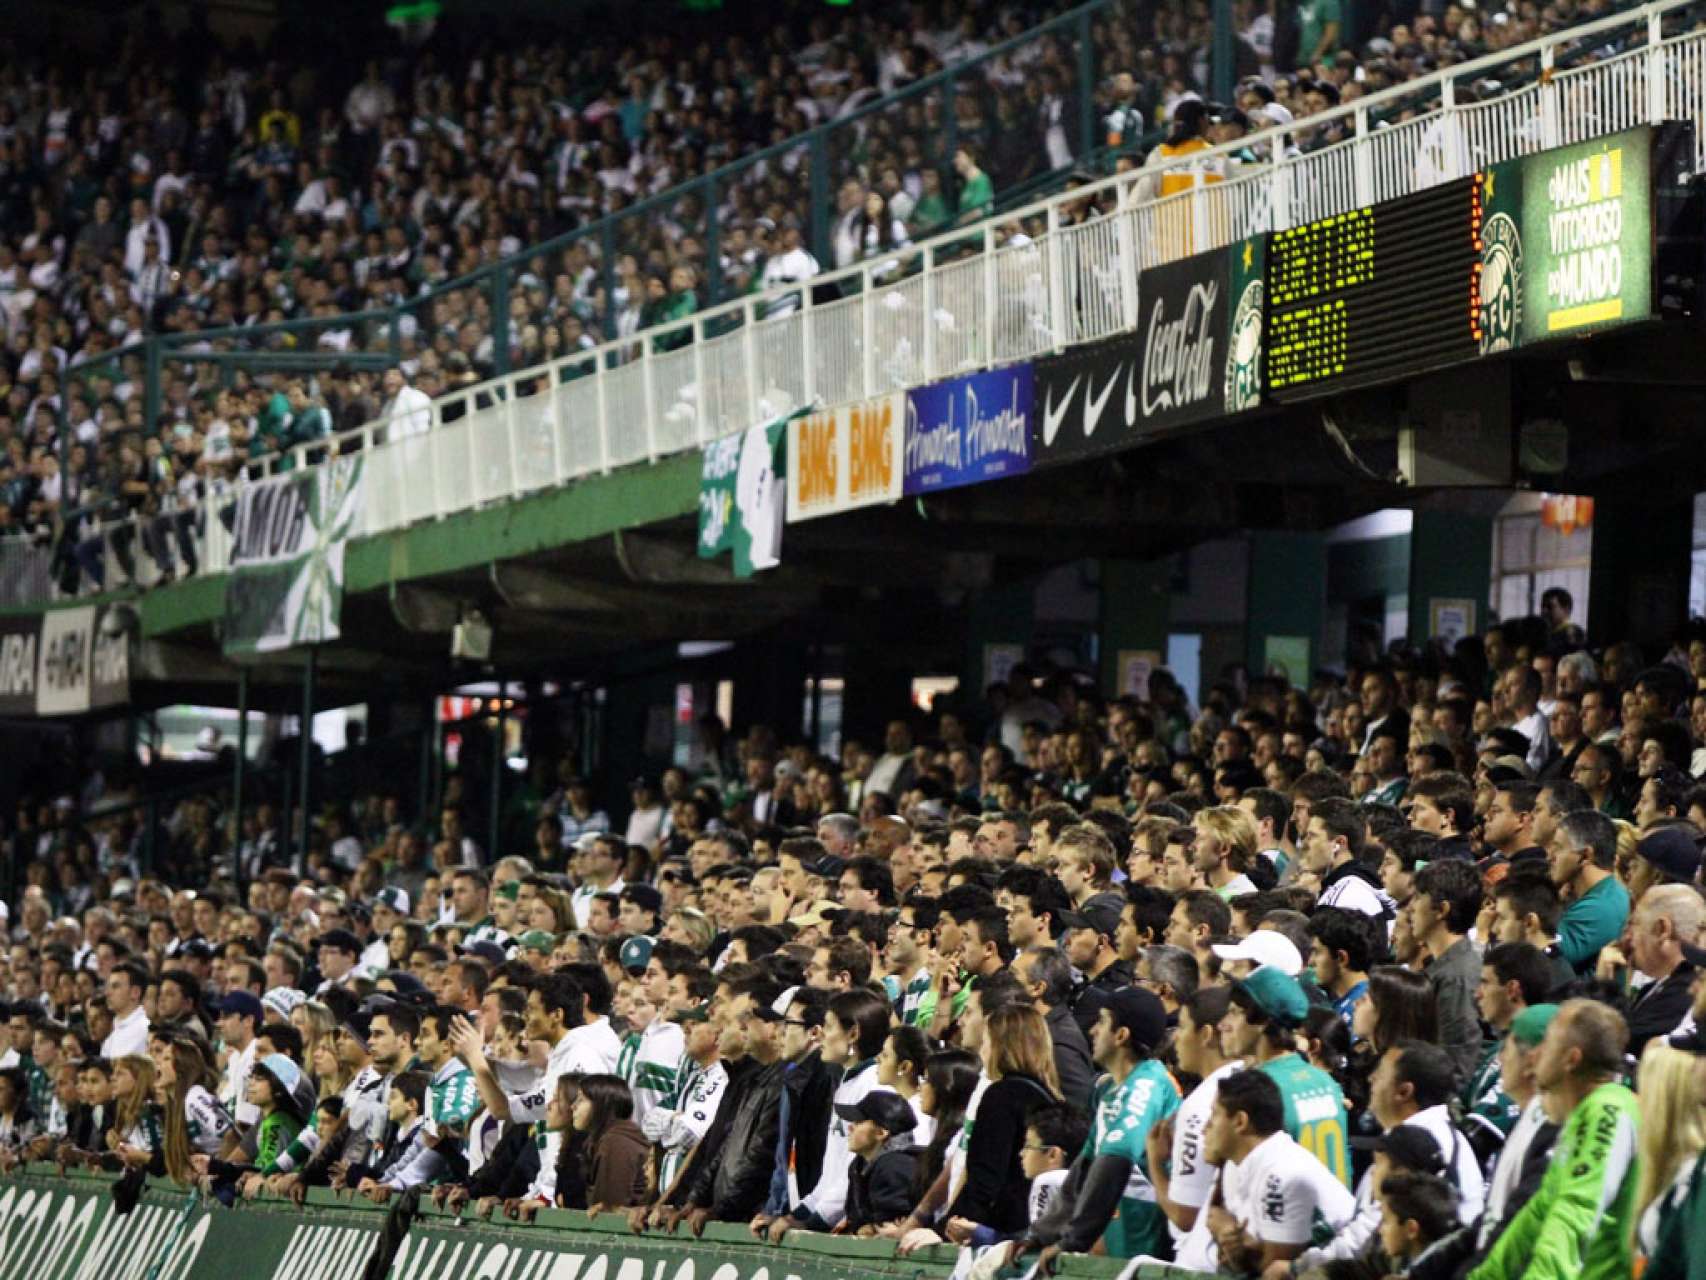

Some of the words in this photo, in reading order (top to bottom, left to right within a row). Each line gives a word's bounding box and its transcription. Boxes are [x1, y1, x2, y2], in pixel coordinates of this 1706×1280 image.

[1556, 157, 1591, 209] MAIS
[1550, 199, 1622, 255] VITORIOSO
[1559, 245, 1622, 306] MUNDO
[1180, 1131, 1199, 1176] IRA
